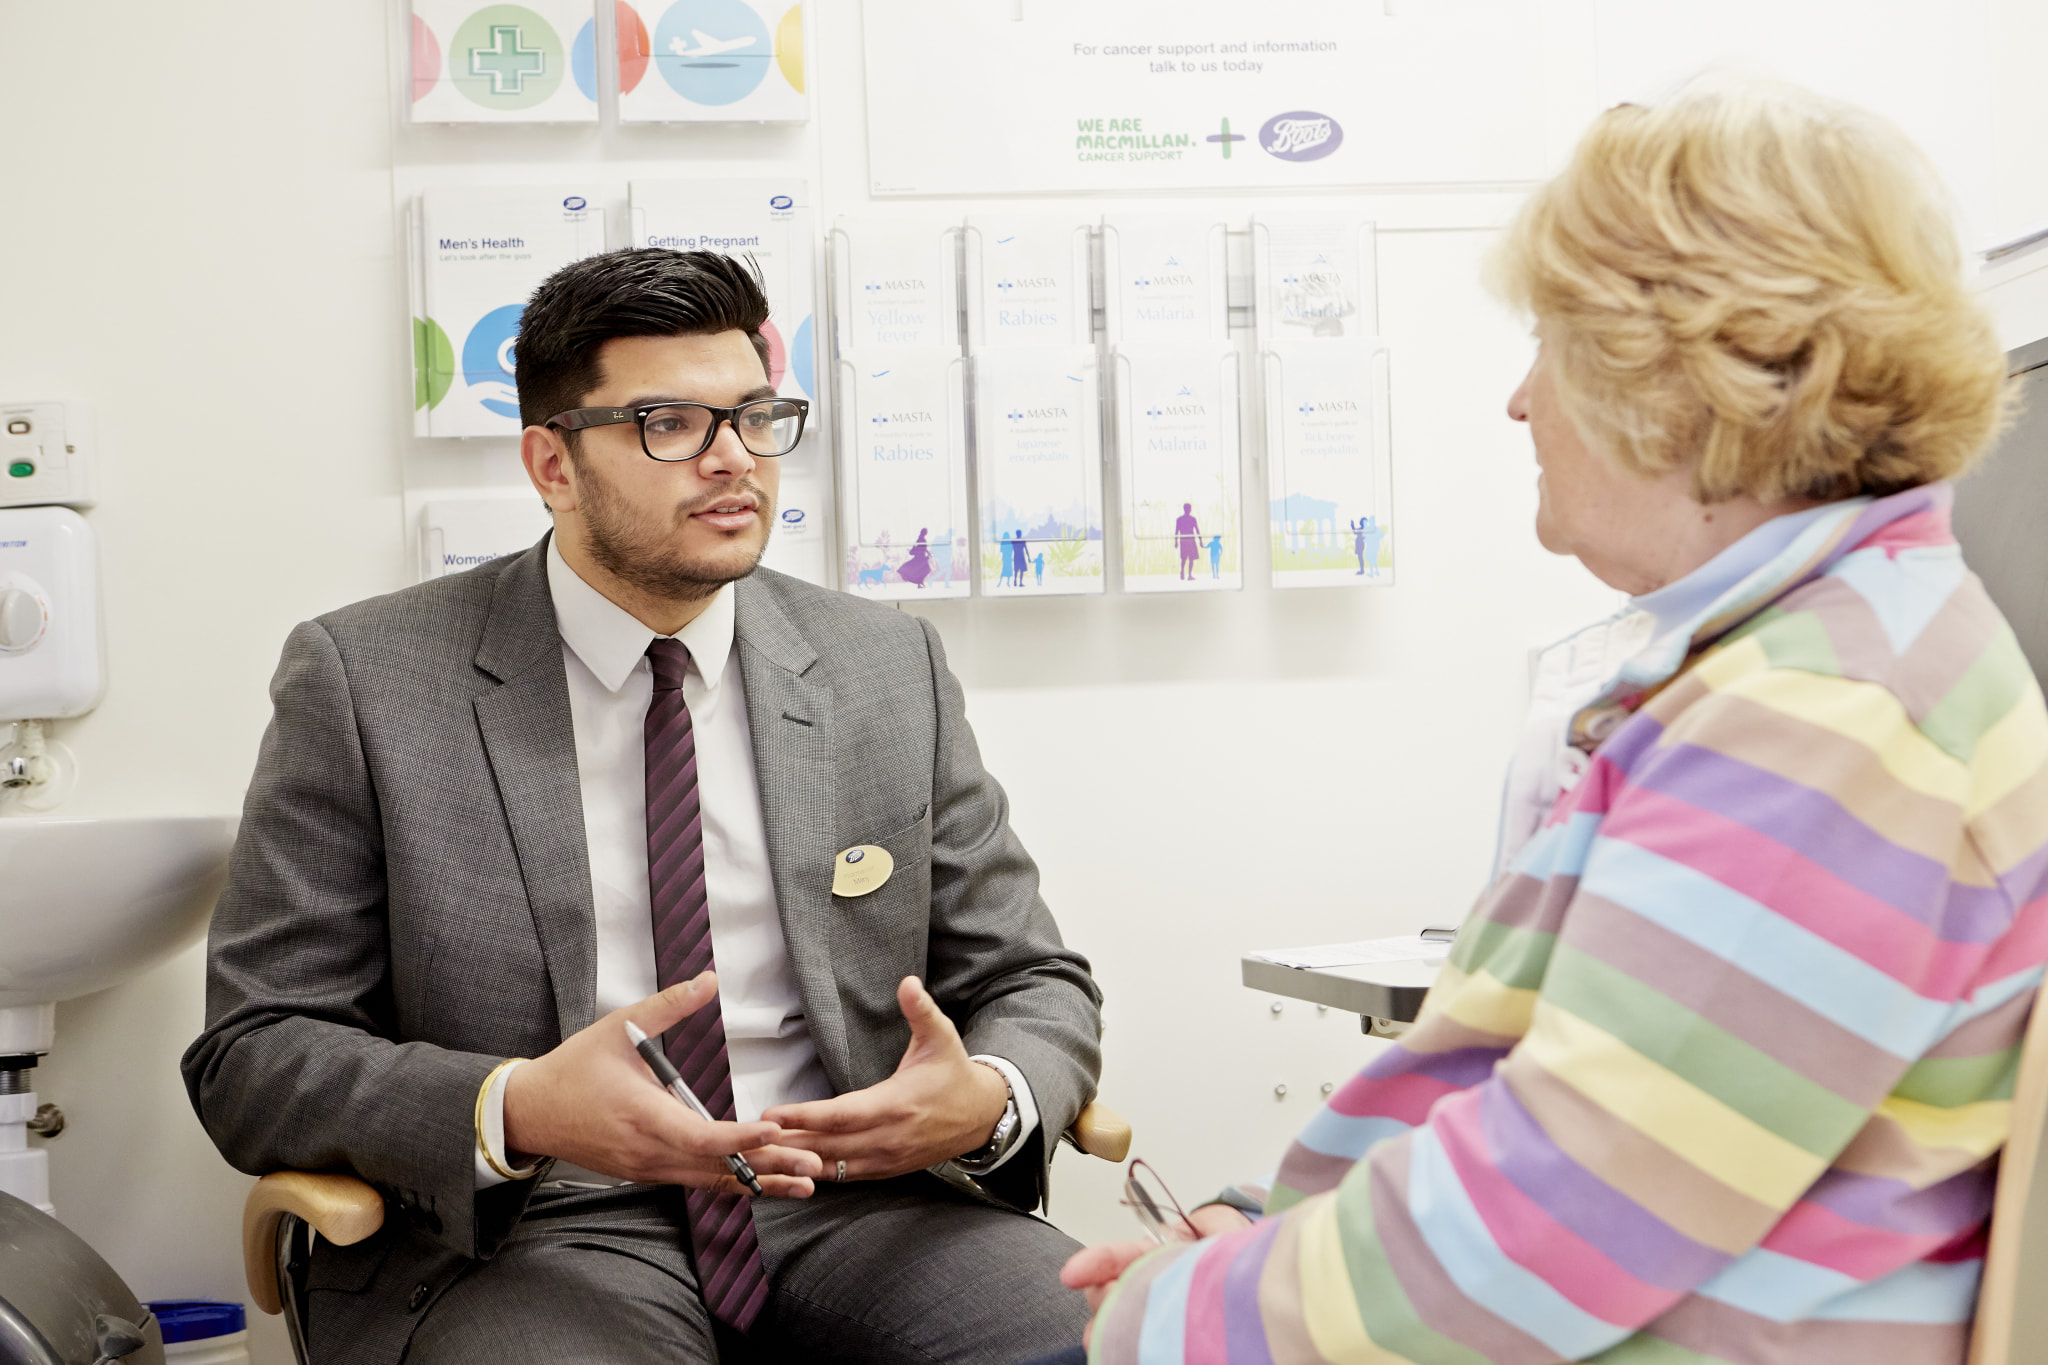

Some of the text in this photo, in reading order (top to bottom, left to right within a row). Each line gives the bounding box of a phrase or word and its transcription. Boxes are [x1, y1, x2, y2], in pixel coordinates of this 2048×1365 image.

[1073, 39, 1337, 57] For cancer support and information
[1149, 59, 1263, 73] talk to us today
[1077, 118, 1142, 132] WE ARE
[1266, 117, 1333, 153] Boots
[1078, 150, 1183, 162] CANCER SUPPORT
[439, 236, 525, 250] Men's Health
[647, 234, 760, 249] Getting Pregnant
[884, 279, 925, 291] MASTA
[1016, 277, 1056, 289] MASTA
[1153, 274, 1193, 286] MASTA
[867, 309, 925, 326] Yellow
[999, 307, 1058, 326] Rabies
[1135, 304, 1194, 321] Malaria
[1166, 404, 1206, 416] MASTA
[1317, 400, 1358, 412] MASTA
[892, 411, 933, 423] MASTA
[1027, 408, 1068, 419] MASTA
[1148, 435, 1207, 452] Malaria
[873, 443, 934, 462] Rabies
[443, 552, 503, 566] Women'
